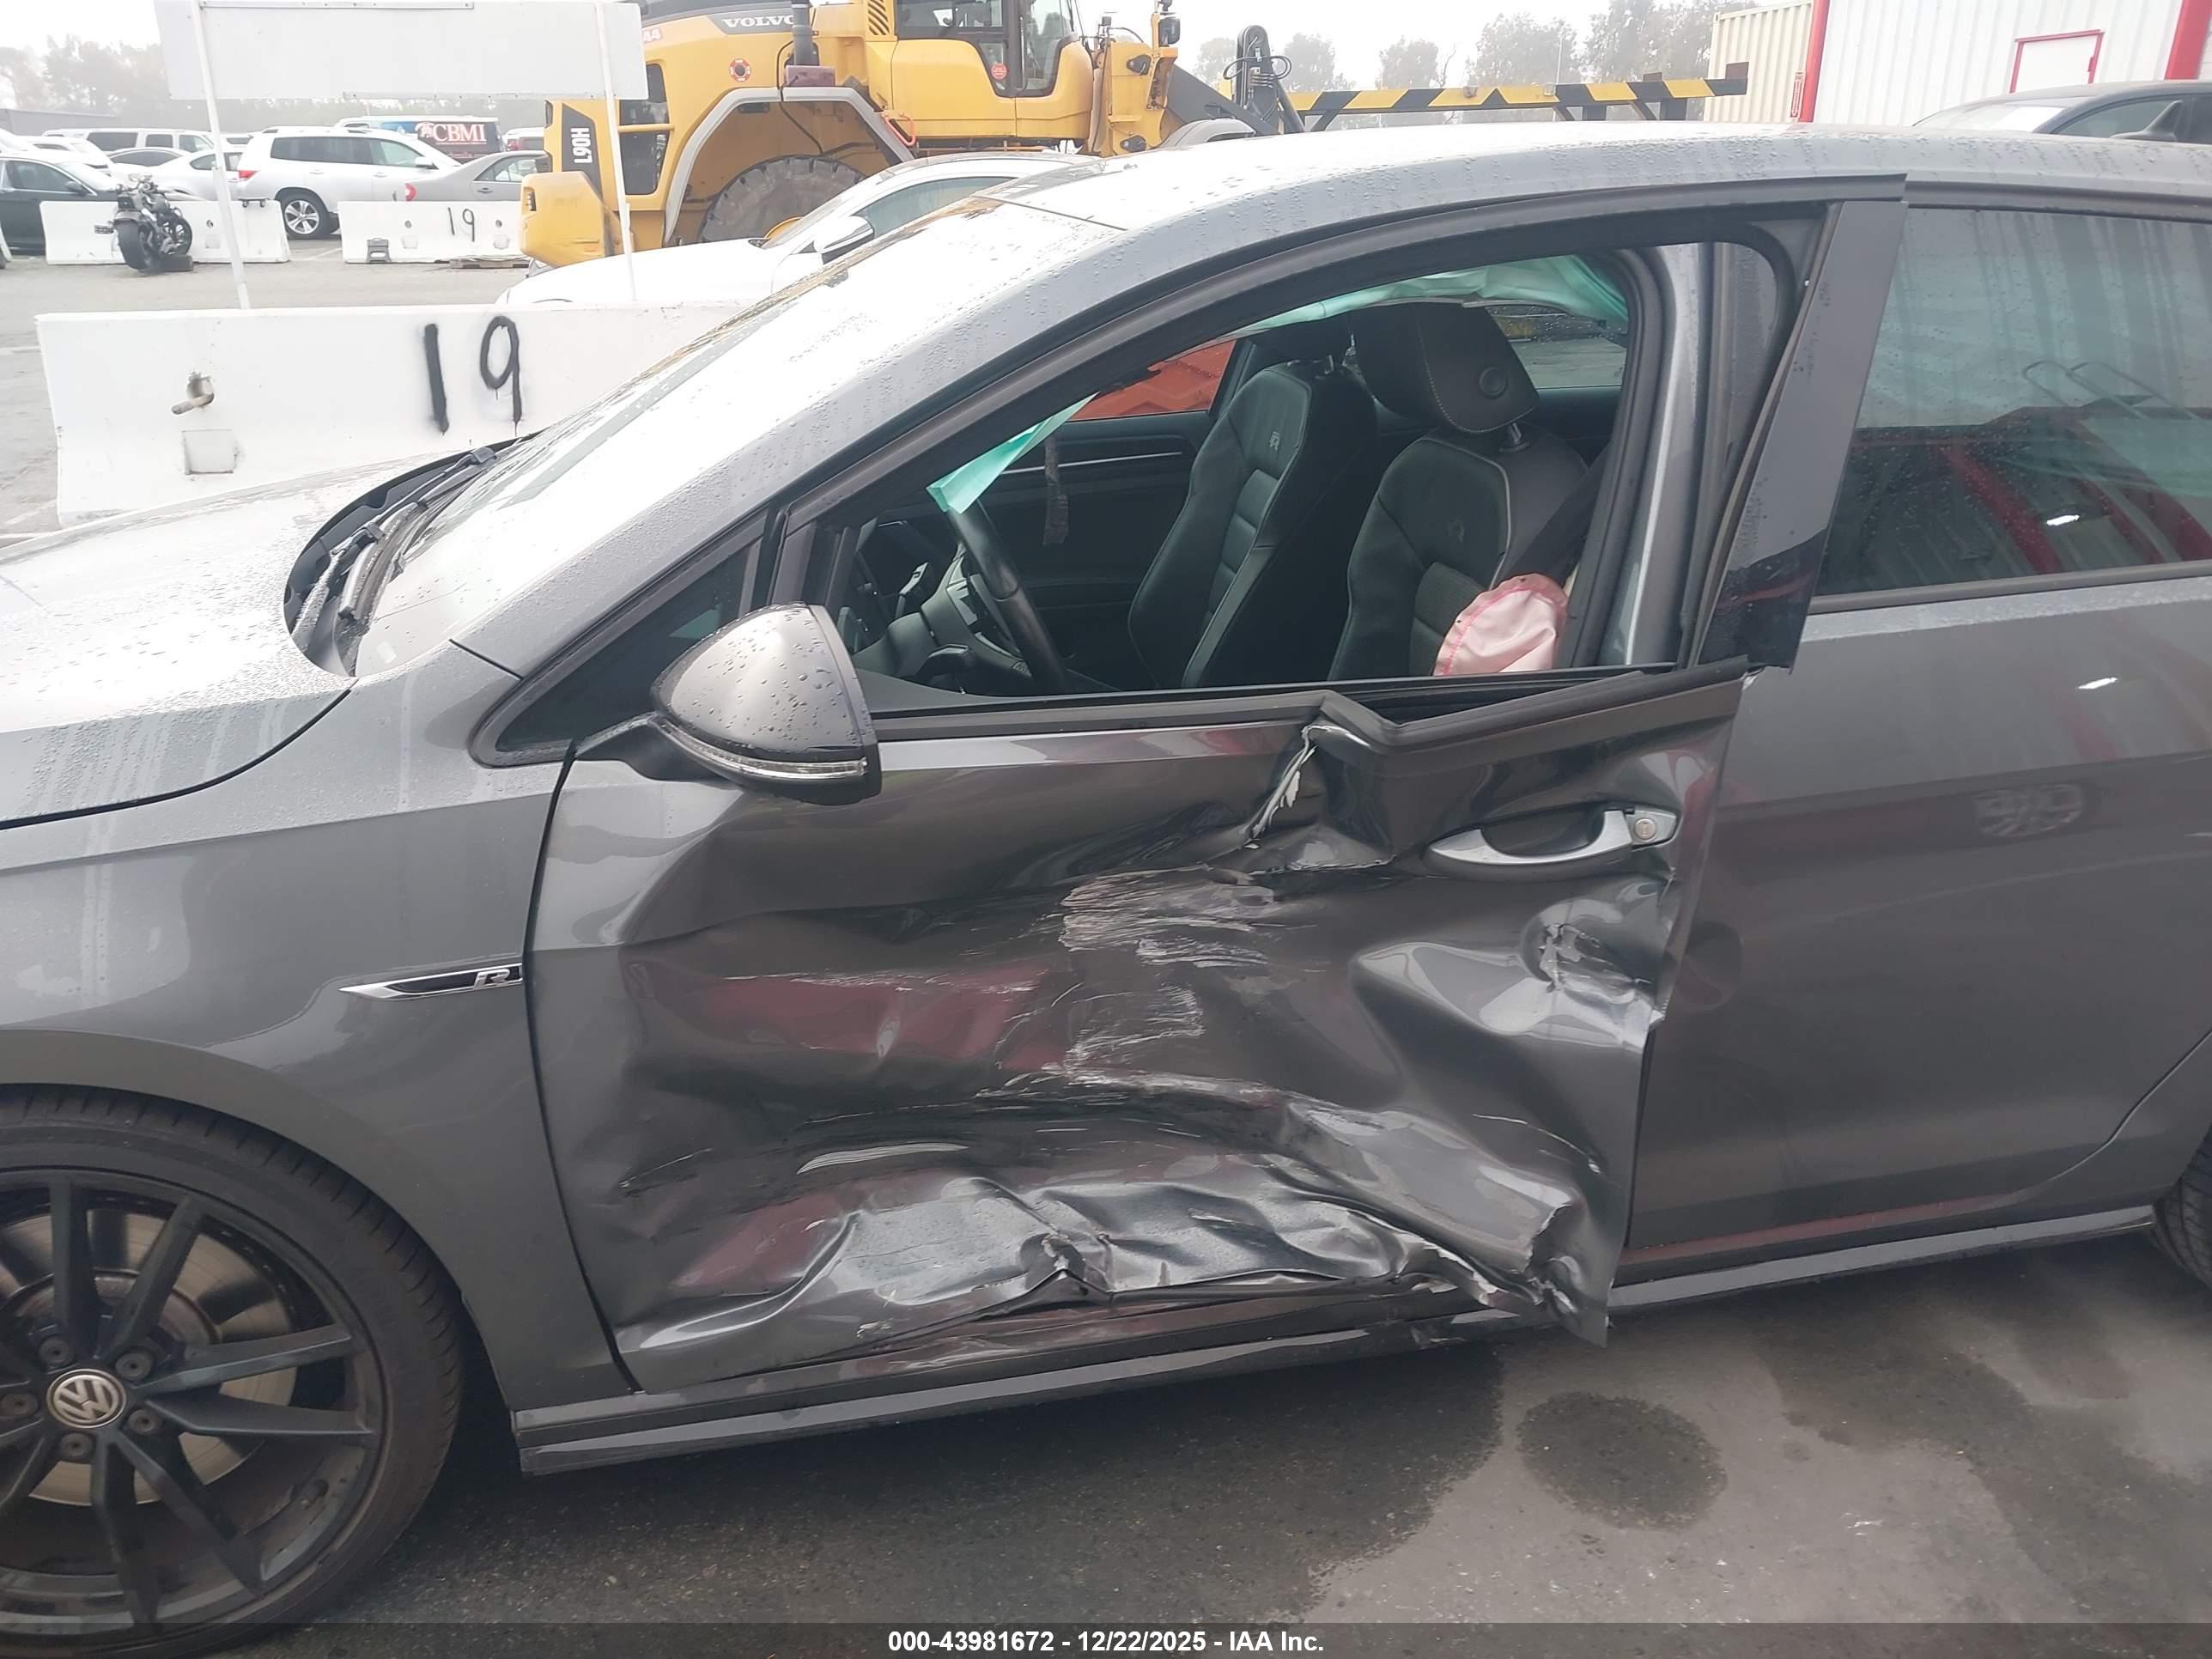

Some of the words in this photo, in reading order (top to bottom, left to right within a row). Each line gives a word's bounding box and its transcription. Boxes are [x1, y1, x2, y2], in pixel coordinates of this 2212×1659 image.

[432, 123, 487, 142] CBMI
[570, 127, 592, 163] L90H
[447, 207, 475, 242] 19
[424, 315, 522, 434] 19
[474, 969, 510, 988] R
